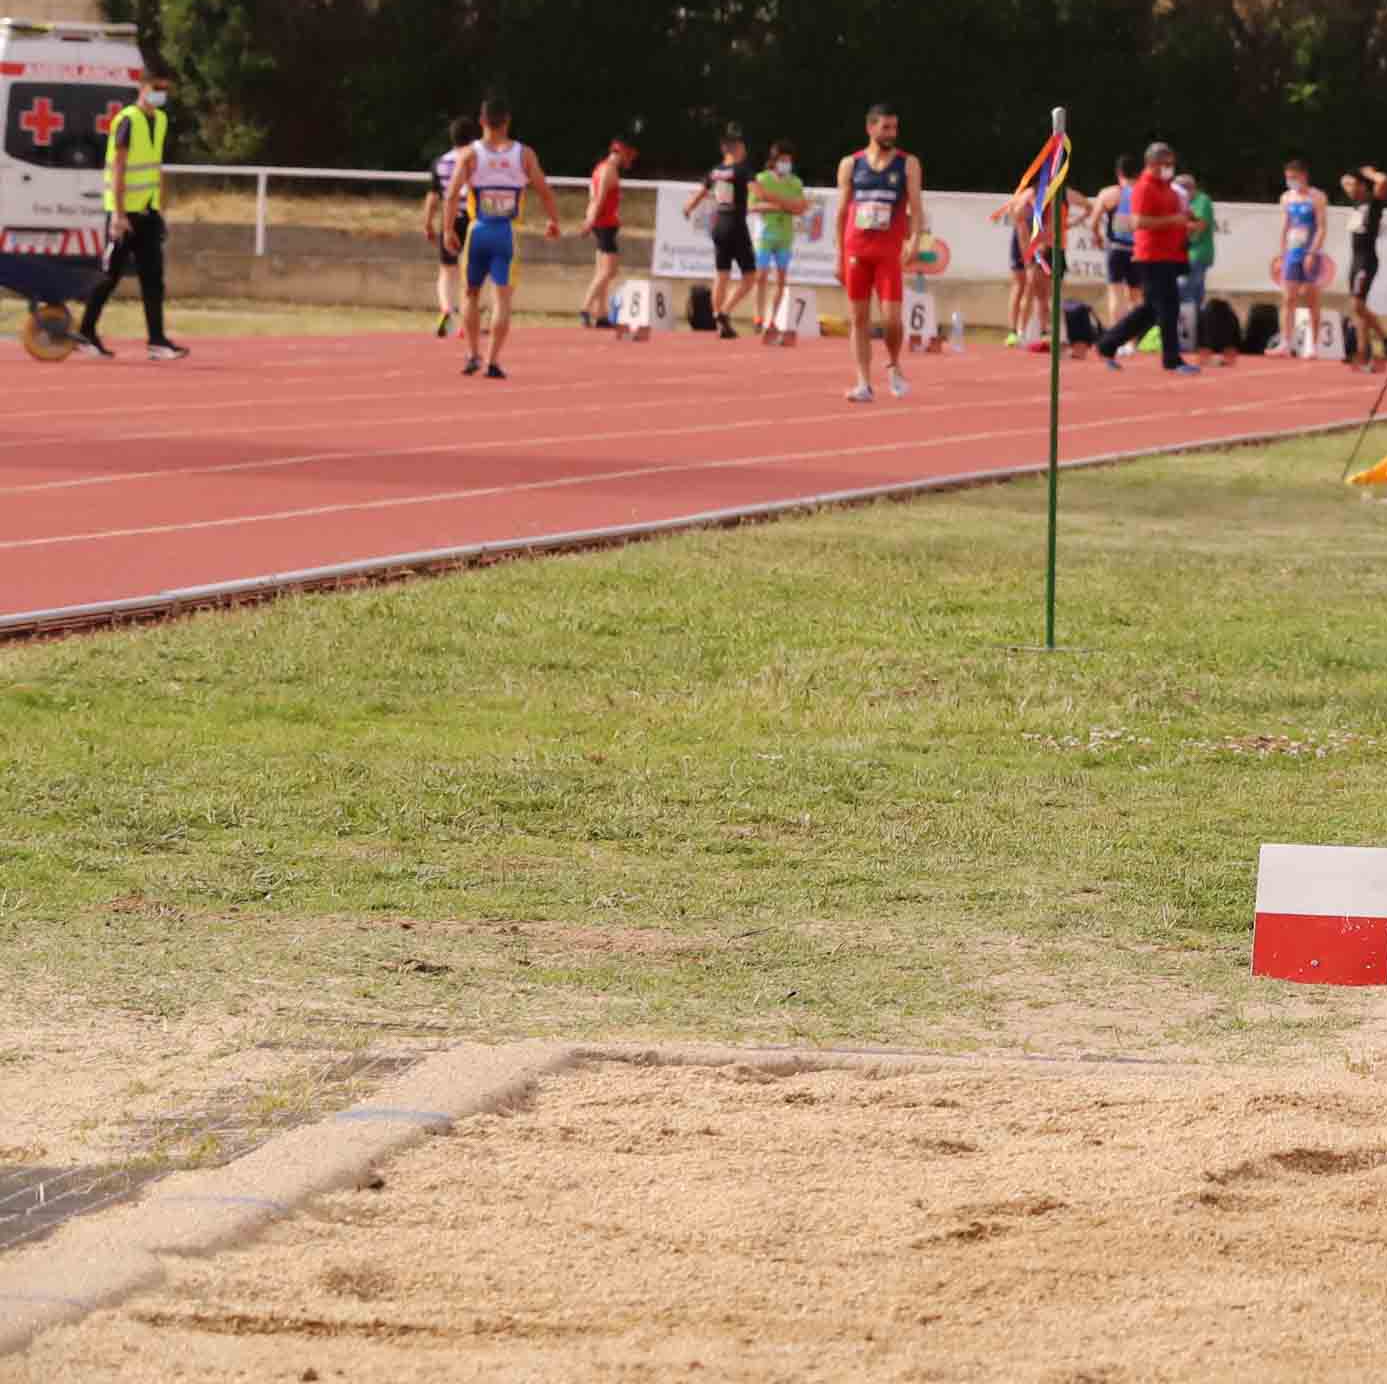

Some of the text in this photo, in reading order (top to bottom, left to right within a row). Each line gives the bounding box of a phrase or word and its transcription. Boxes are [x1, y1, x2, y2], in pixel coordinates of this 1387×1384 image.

[655, 291, 667, 320] 8
[794, 297, 807, 327] 7
[910, 303, 926, 331] 6
